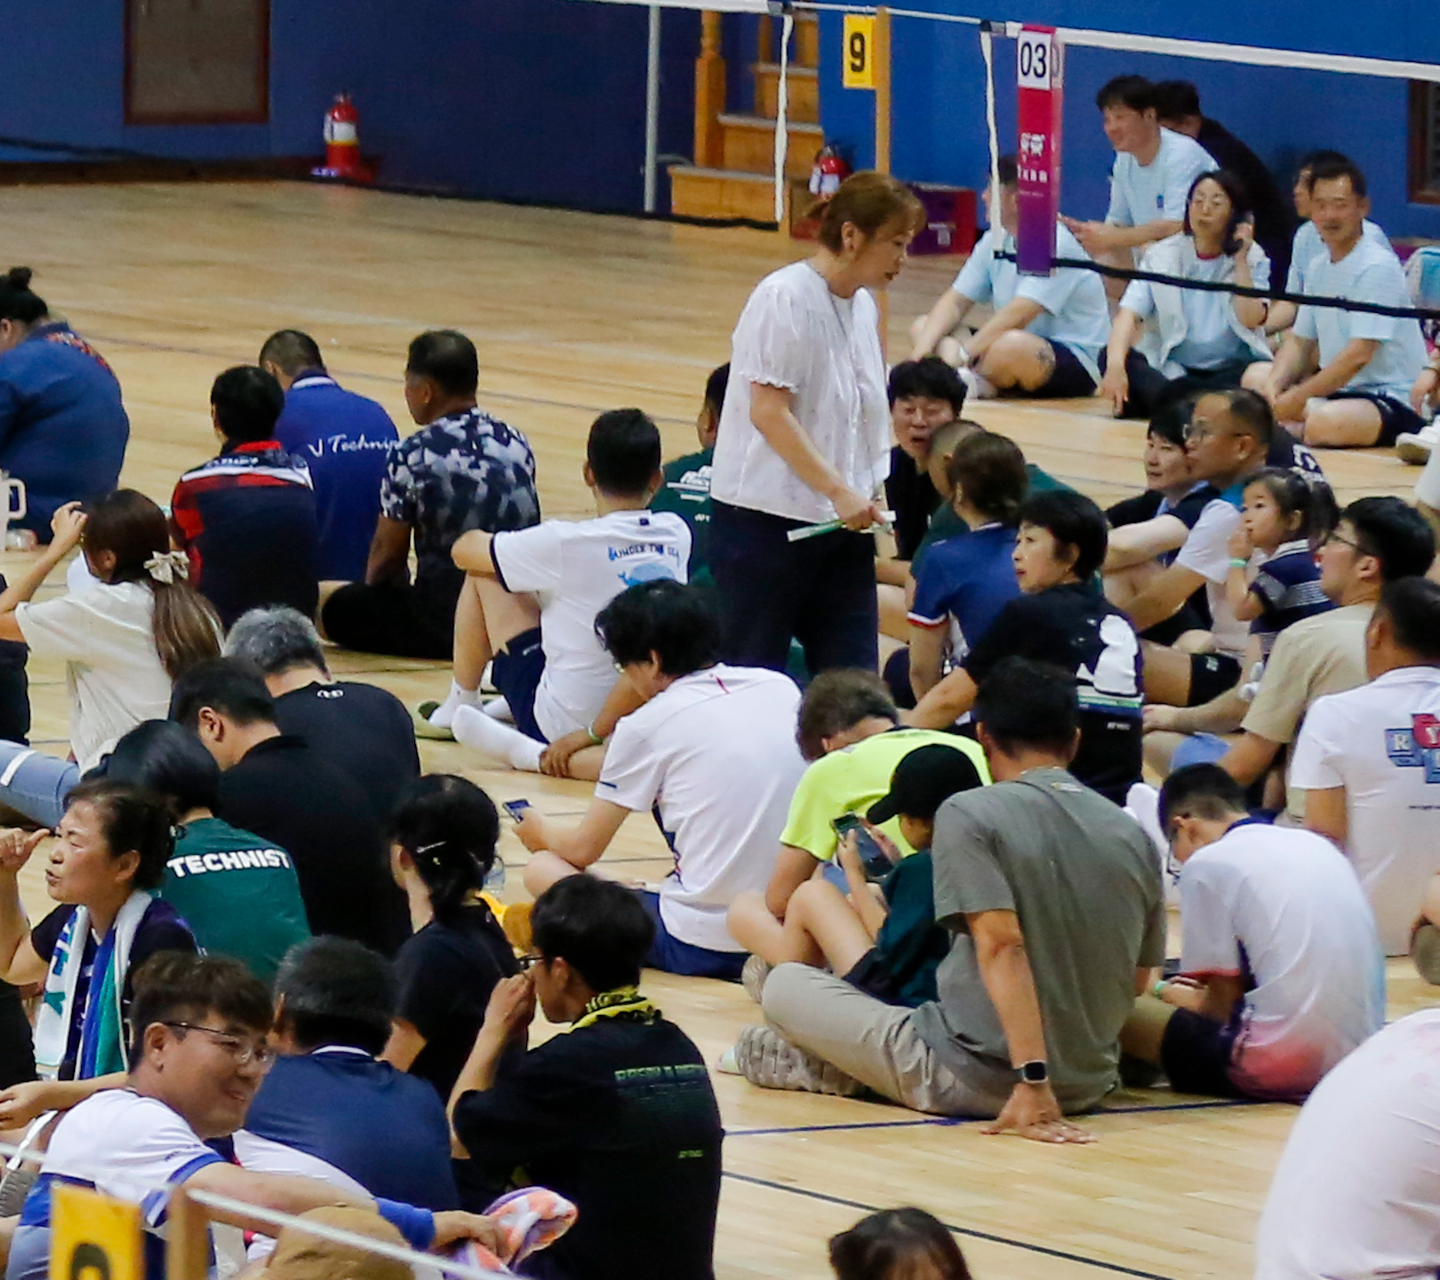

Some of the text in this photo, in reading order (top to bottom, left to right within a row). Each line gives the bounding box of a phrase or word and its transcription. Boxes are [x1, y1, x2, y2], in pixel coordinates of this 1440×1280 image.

[849, 31, 867, 73] 9
[1020, 42, 1048, 79] 03
[166, 848, 290, 878] TECHNIST
